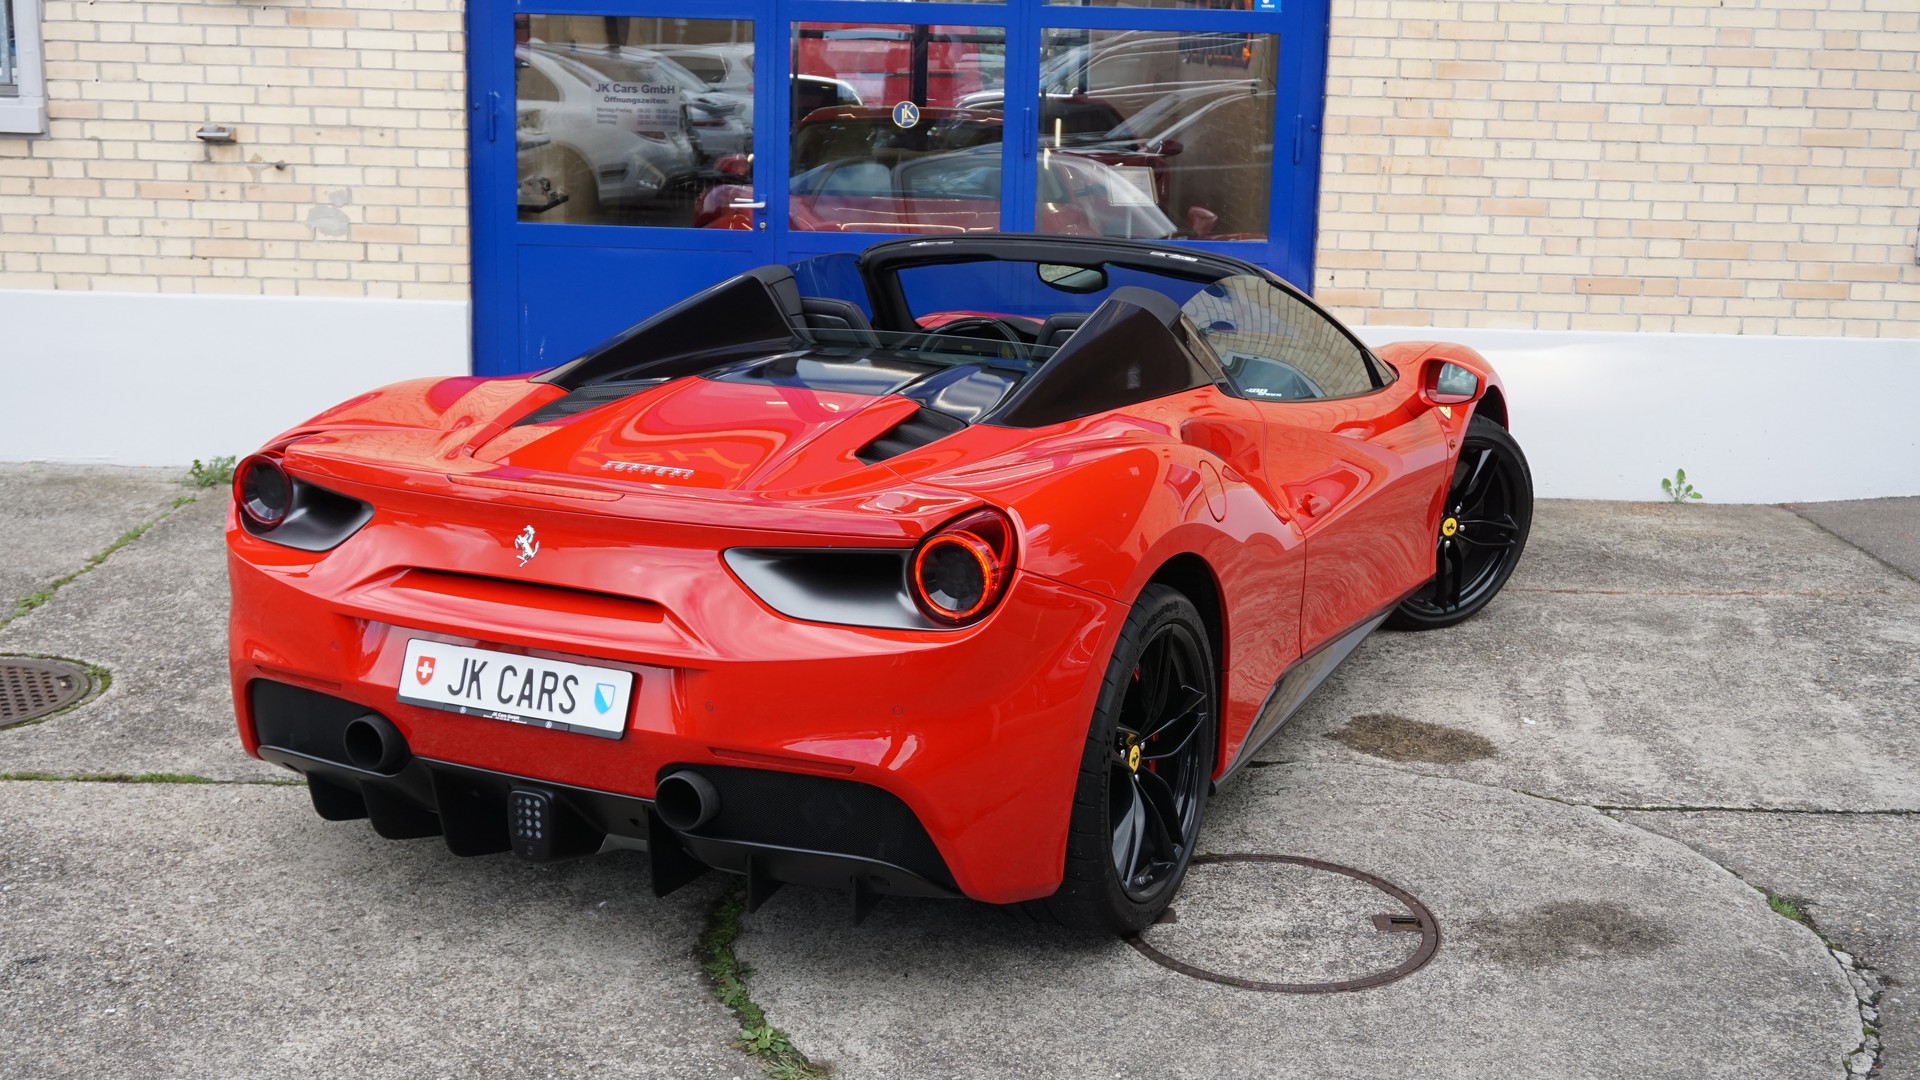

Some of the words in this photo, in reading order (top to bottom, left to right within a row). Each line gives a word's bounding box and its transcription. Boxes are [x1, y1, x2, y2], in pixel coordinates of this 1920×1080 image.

[595, 83, 610, 93] JK
[612, 83, 638, 94] Cars
[641, 84, 675, 94] GmbH
[603, 95, 670, 105] Öffnungszeiten:
[447, 657, 489, 700] JK
[496, 664, 579, 715] CARS
